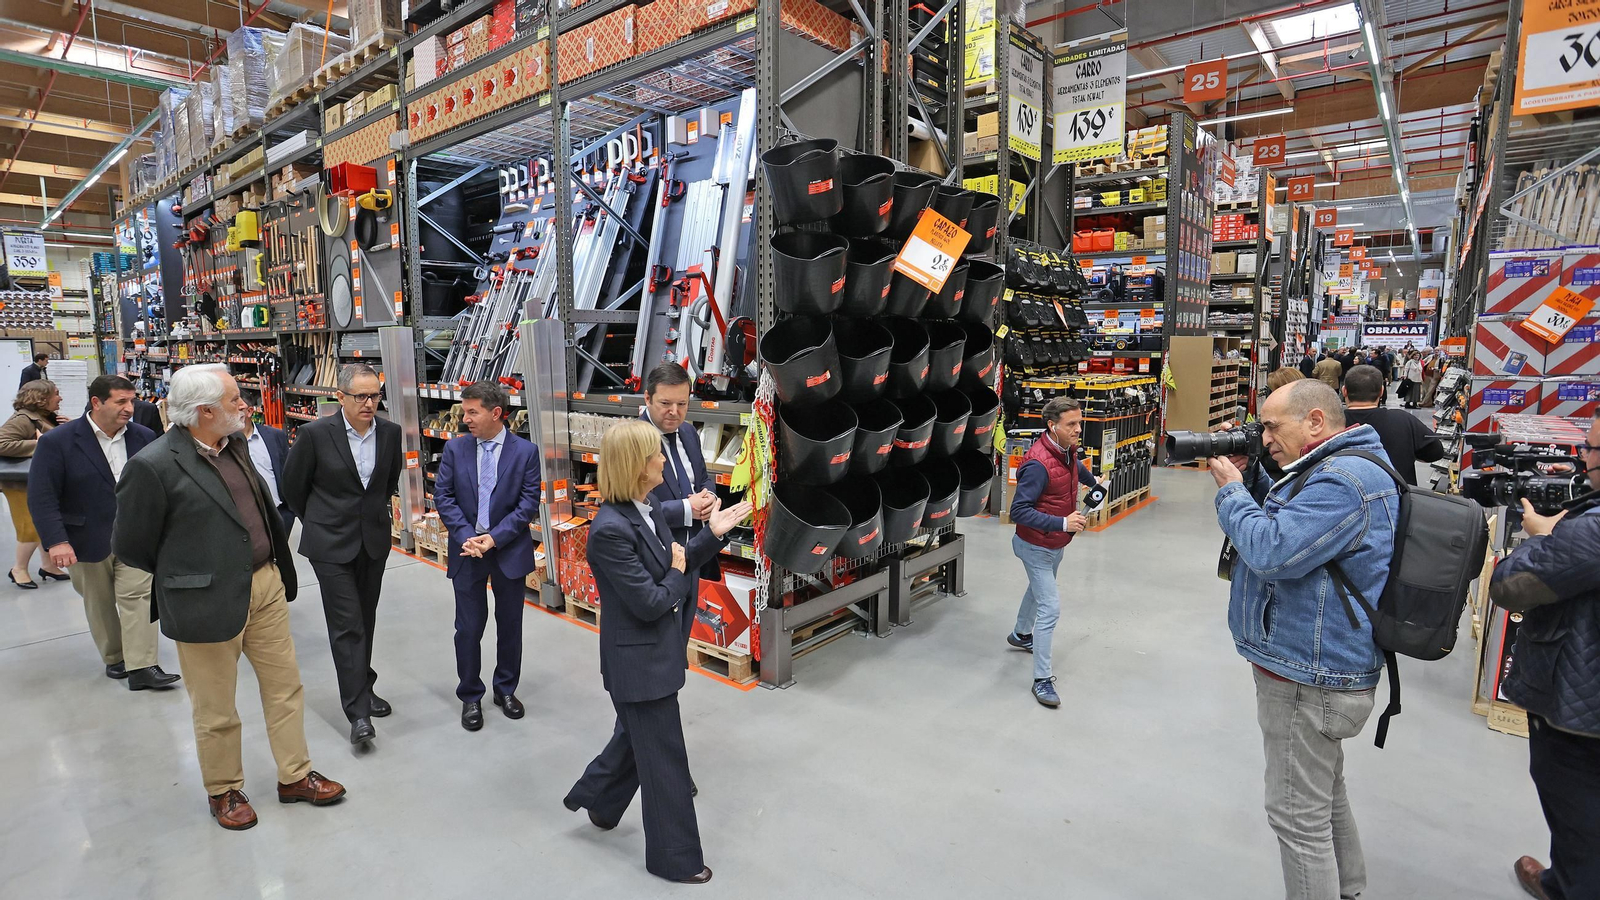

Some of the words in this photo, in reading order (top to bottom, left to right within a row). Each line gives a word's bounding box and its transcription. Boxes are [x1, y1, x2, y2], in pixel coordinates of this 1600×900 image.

[1054, 53, 1087, 65] UNIDADES
[1089, 44, 1125, 56] LIMITADAS
[1075, 60, 1101, 79] CARRO
[1095, 76, 1121, 89] ELEMENTOS
[1191, 71, 1220, 92] 25
[1258, 144, 1280, 159] 23
[1293, 183, 1309, 195] 21
[1319, 213, 1333, 223] 19
[934, 218, 958, 239] CAPAZO
[1338, 233, 1350, 241] 17
[1367, 325, 1425, 335] OBRAMAT
